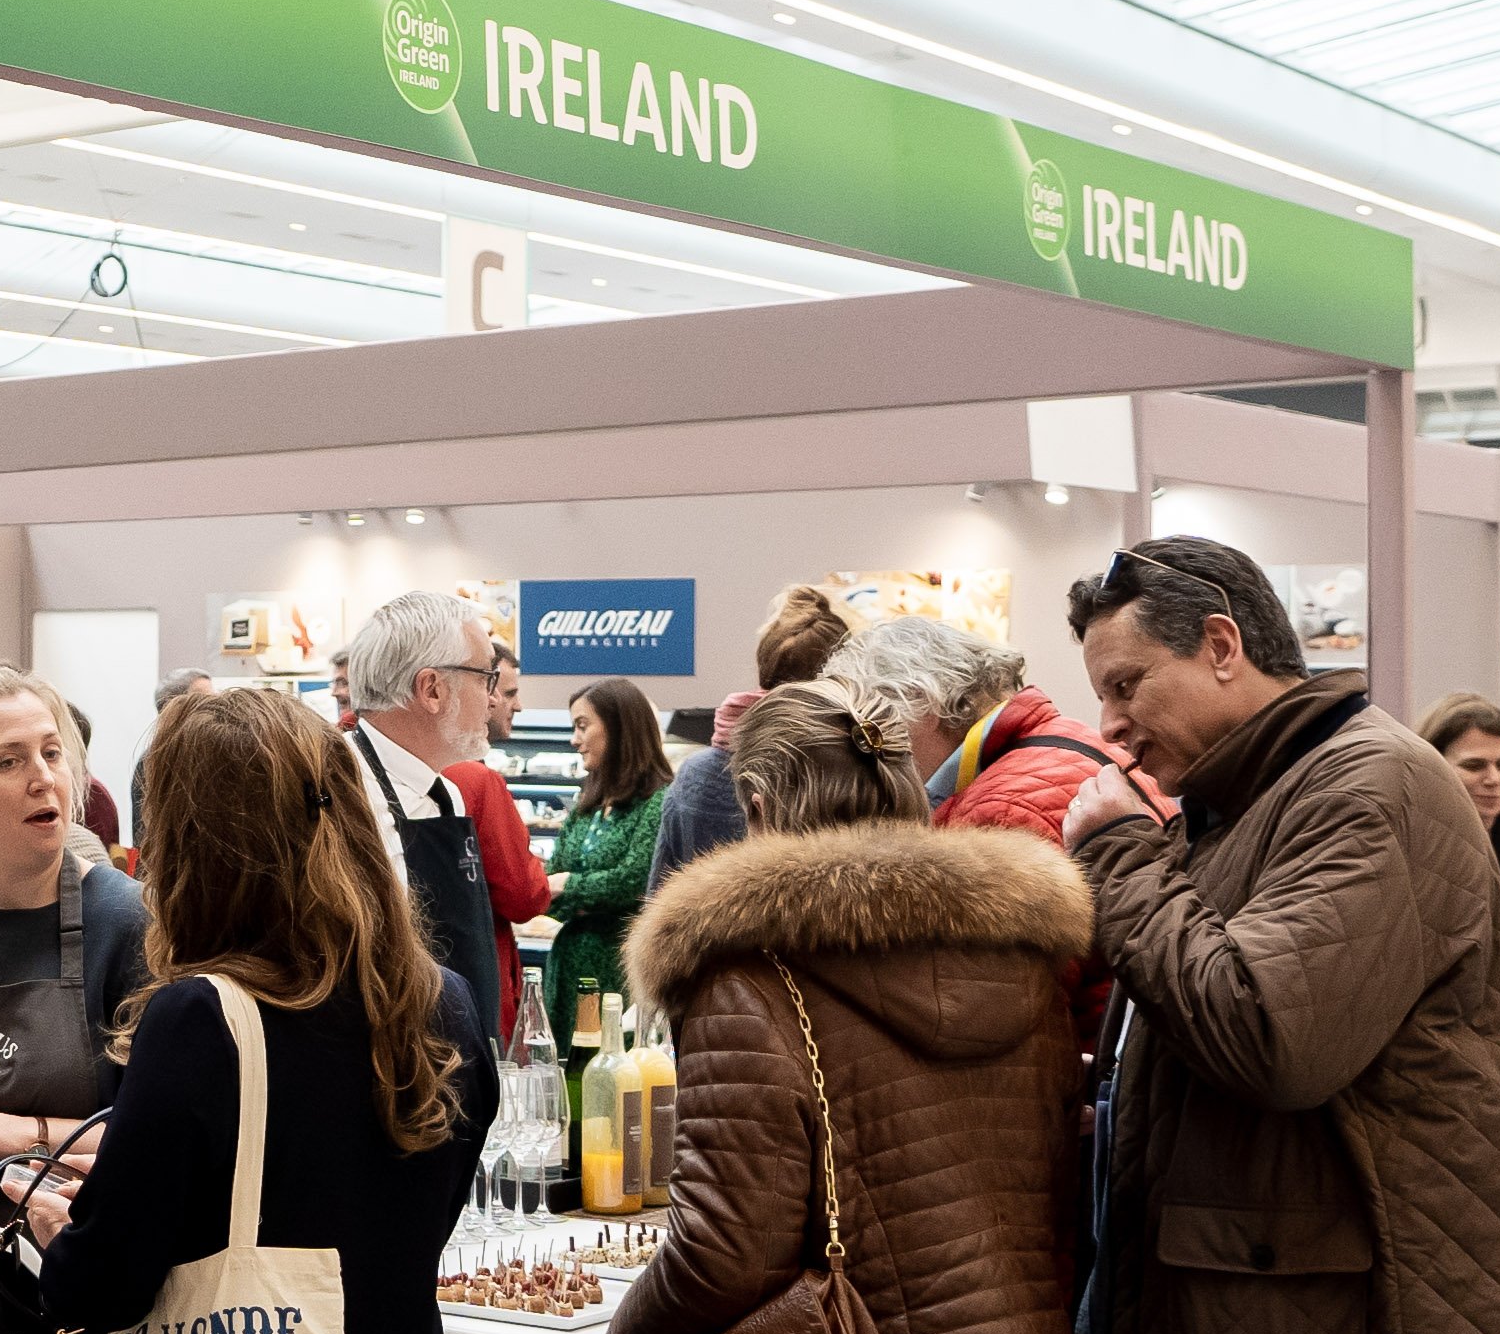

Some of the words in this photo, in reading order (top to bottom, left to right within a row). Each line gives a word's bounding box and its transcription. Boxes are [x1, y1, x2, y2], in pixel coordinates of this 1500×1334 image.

[397, 10, 449, 48] Origin
[397, 38, 450, 74] Green
[399, 69, 440, 90] IRELAND
[484, 19, 758, 170] IRELAND
[1083, 184, 1248, 291] IRELAND
[538, 609, 674, 636] GUILLOTEAU
[539, 638, 658, 648] FROMAGERIE
